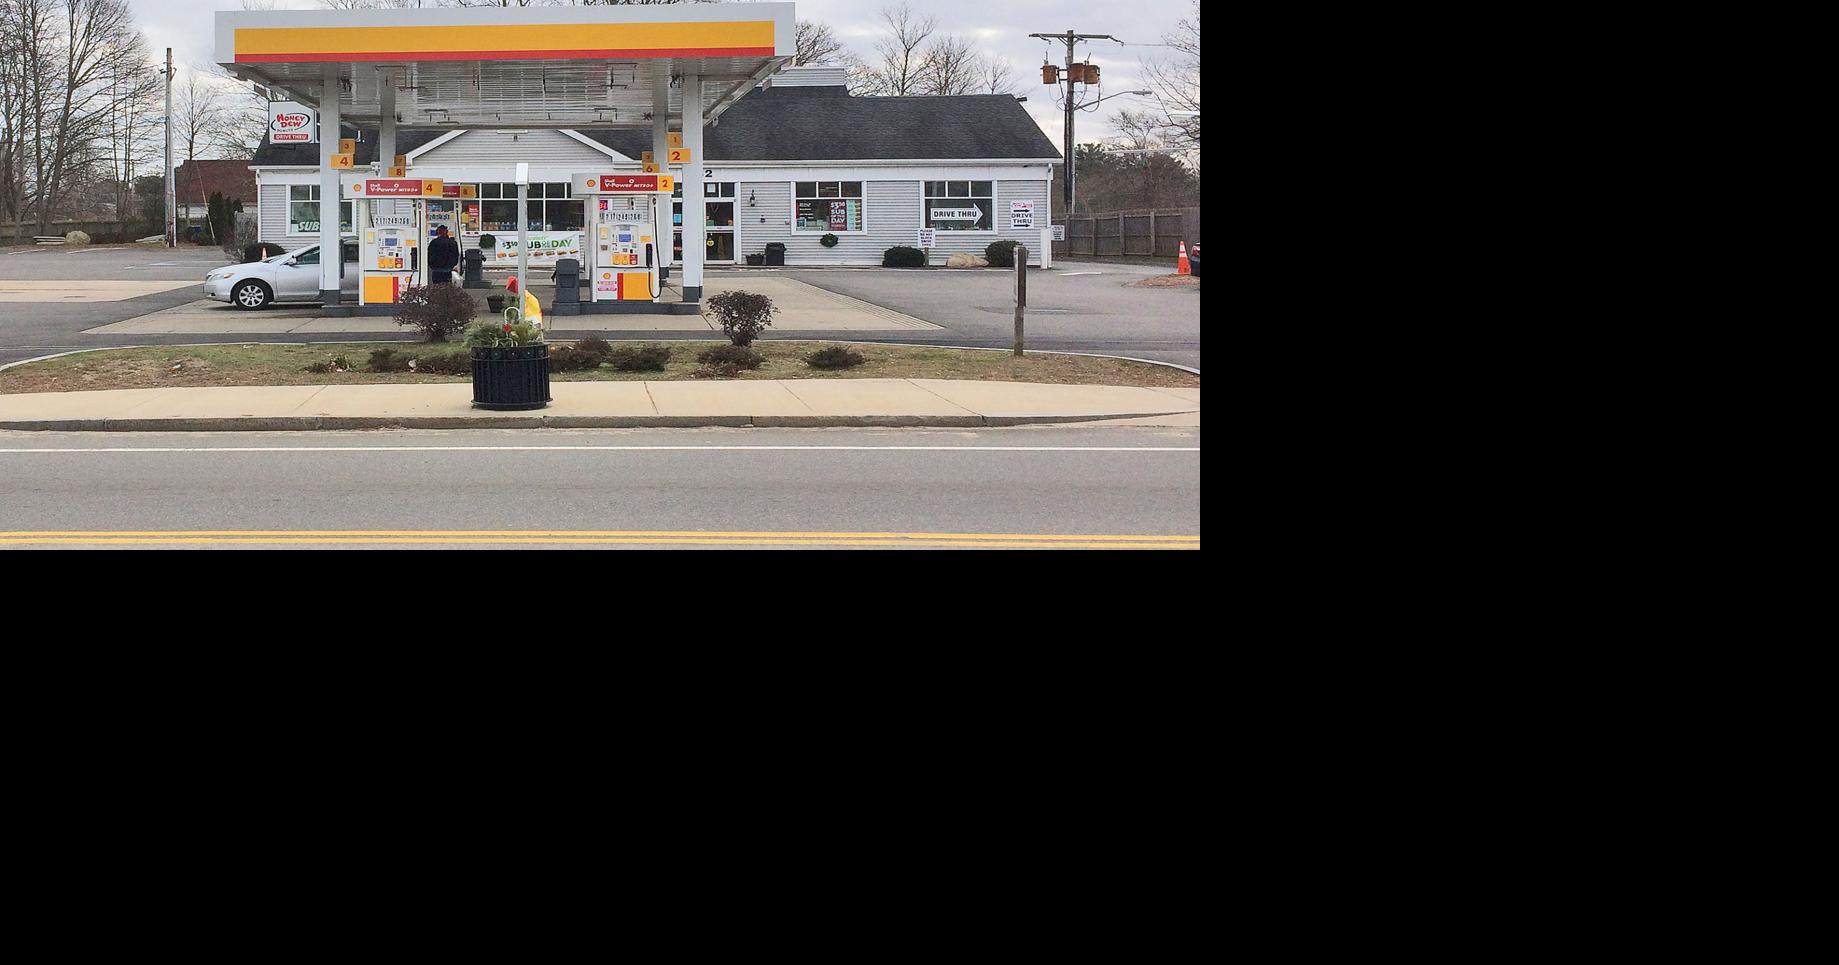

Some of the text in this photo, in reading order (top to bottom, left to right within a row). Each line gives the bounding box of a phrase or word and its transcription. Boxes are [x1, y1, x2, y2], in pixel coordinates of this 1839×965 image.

[671, 151, 681, 161] 2
[340, 156, 349, 166] 4
[396, 168, 402, 176] 8
[646, 165, 653, 173] 6
[704, 169, 713, 178] 2
[426, 184, 433, 193] 4
[662, 180, 670, 188] 2
[933, 210, 977, 218] DRIVE THRU
[298, 221, 320, 232] SUB
[526, 241, 541, 249] UB
[551, 239, 572, 248] DAY
